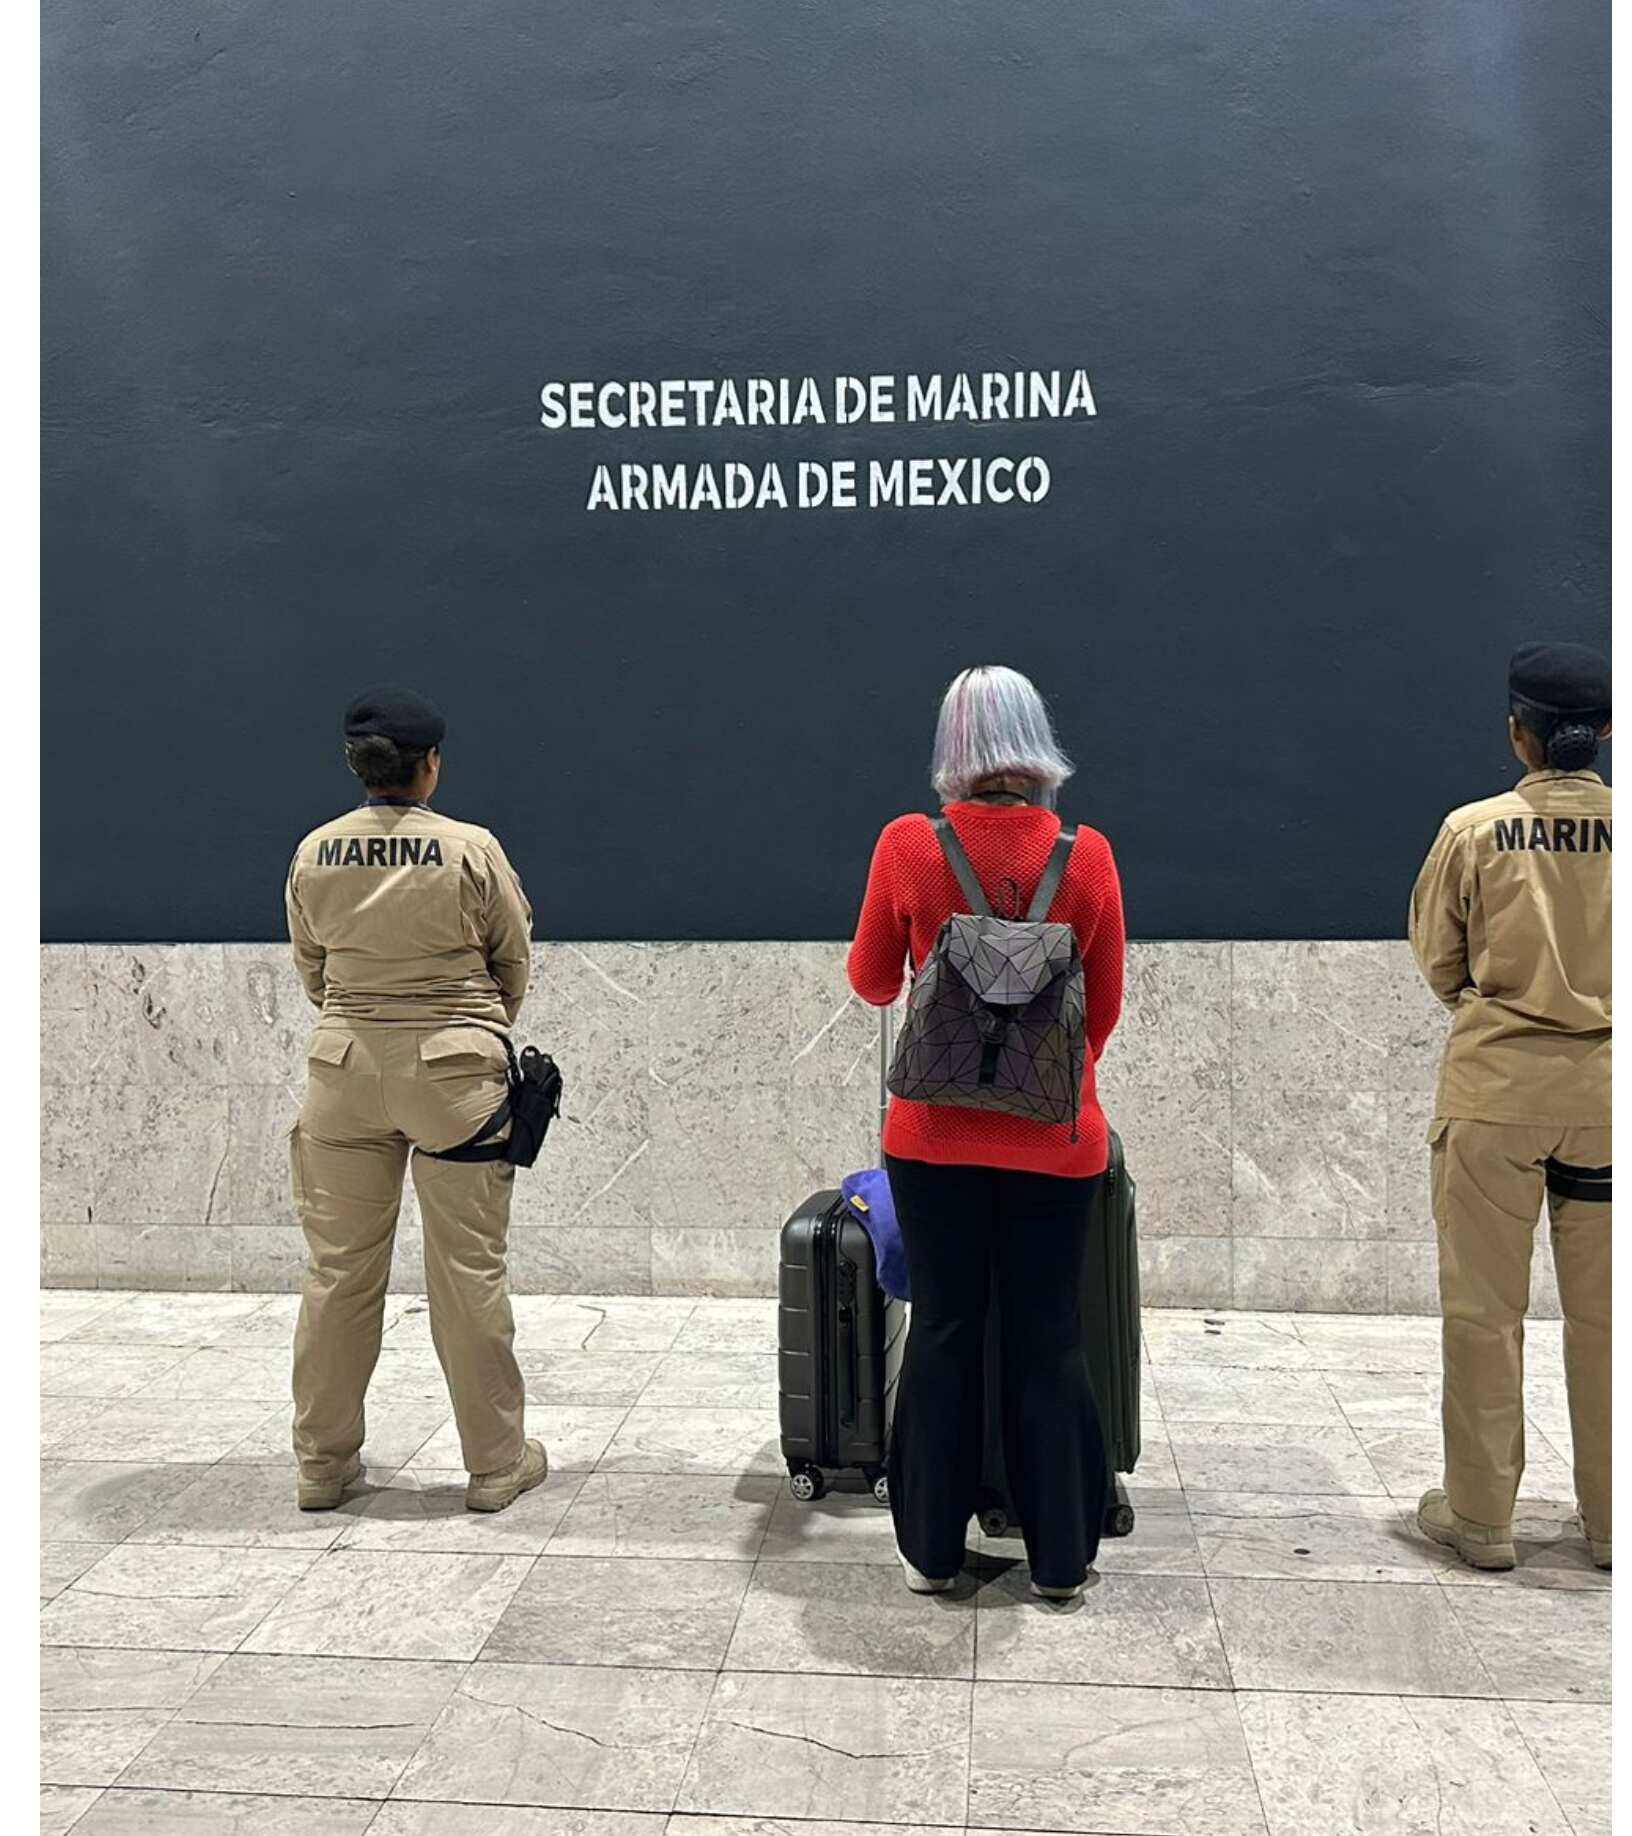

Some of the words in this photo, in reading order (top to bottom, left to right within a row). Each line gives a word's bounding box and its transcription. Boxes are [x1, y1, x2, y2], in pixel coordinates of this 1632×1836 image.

[540, 377, 827, 429] SECRETARIA
[835, 375, 895, 424] DE
[907, 369, 1097, 422] MARINA
[587, 463, 788, 511] ARMADA
[798, 461, 857, 508] DE
[869, 456, 1051, 507] MEXICO
[316, 837, 444, 867] MARINA
